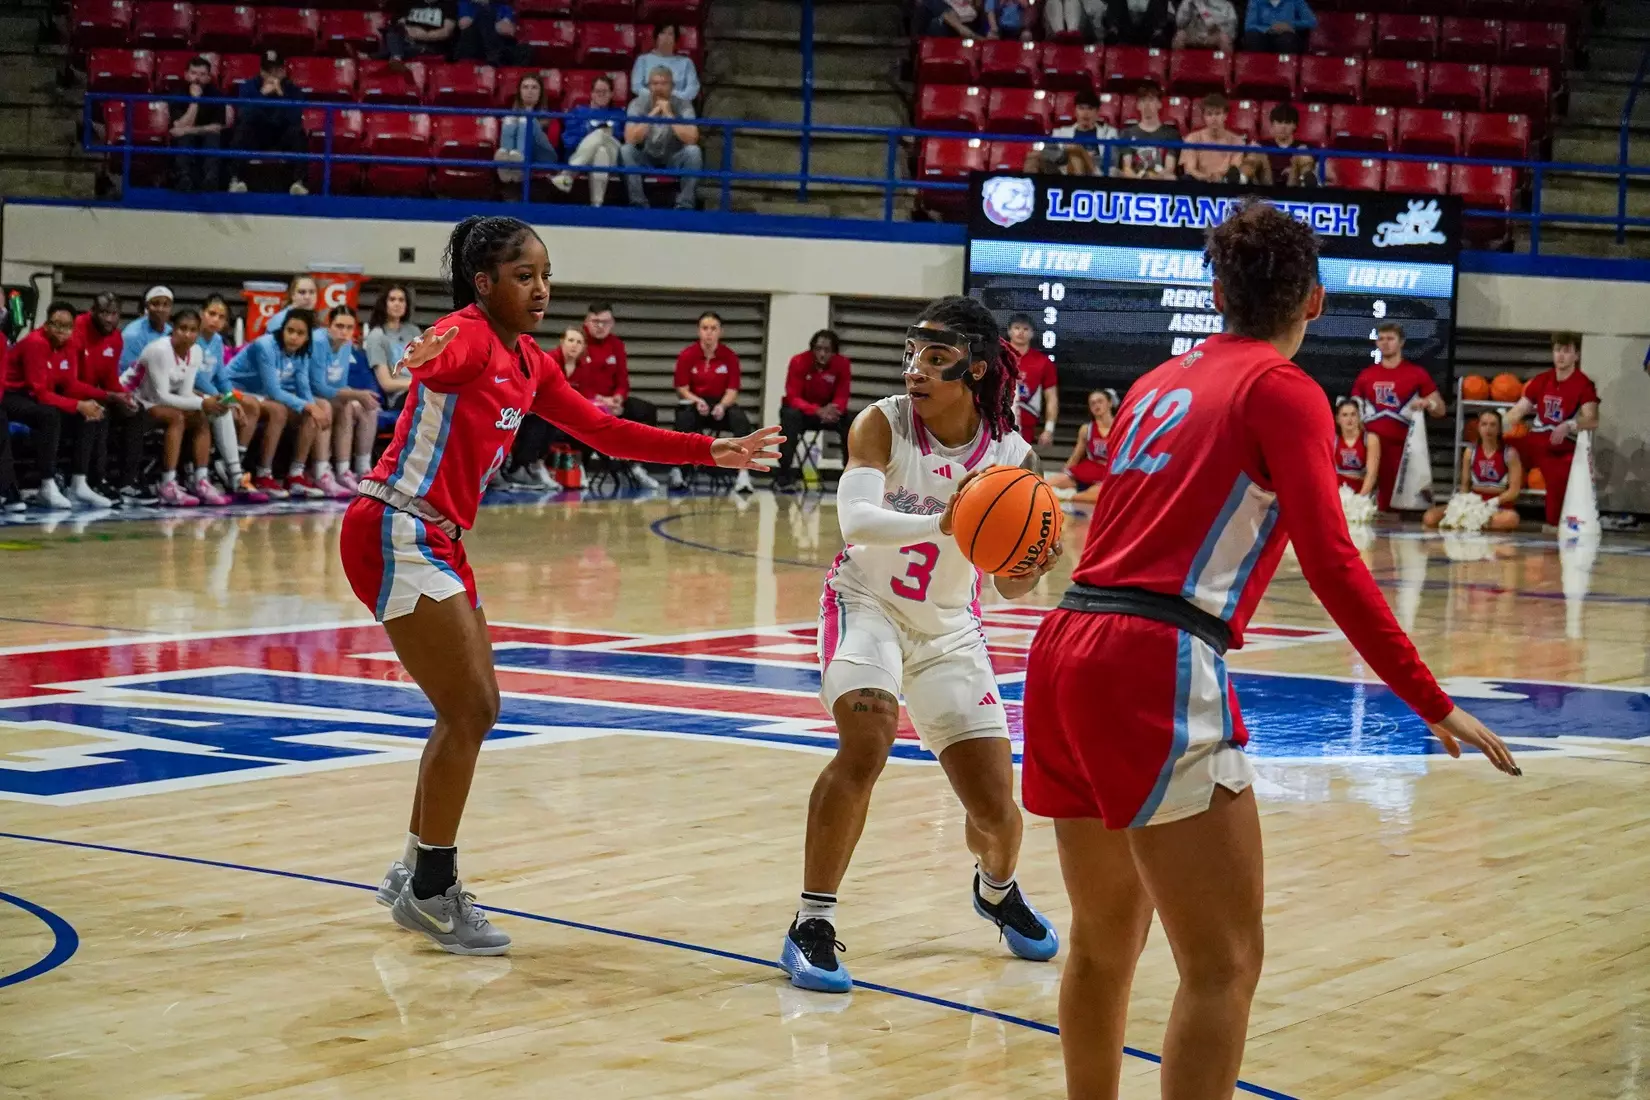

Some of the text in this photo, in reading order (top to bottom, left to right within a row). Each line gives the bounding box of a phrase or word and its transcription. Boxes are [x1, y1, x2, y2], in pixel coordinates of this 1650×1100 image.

[1020, 247, 1093, 271] LA TECH
[1346, 265, 1421, 290] LIBERTY
[325, 282, 347, 309] G
[1037, 281, 1066, 301] 10
[1042, 305, 1059, 325] 3
[1372, 299, 1387, 319] 9
[1041, 329, 1057, 349] 0
[1110, 387, 1193, 475] 12
[1006, 511, 1052, 574] Wilson
[889, 541, 941, 602] 3
